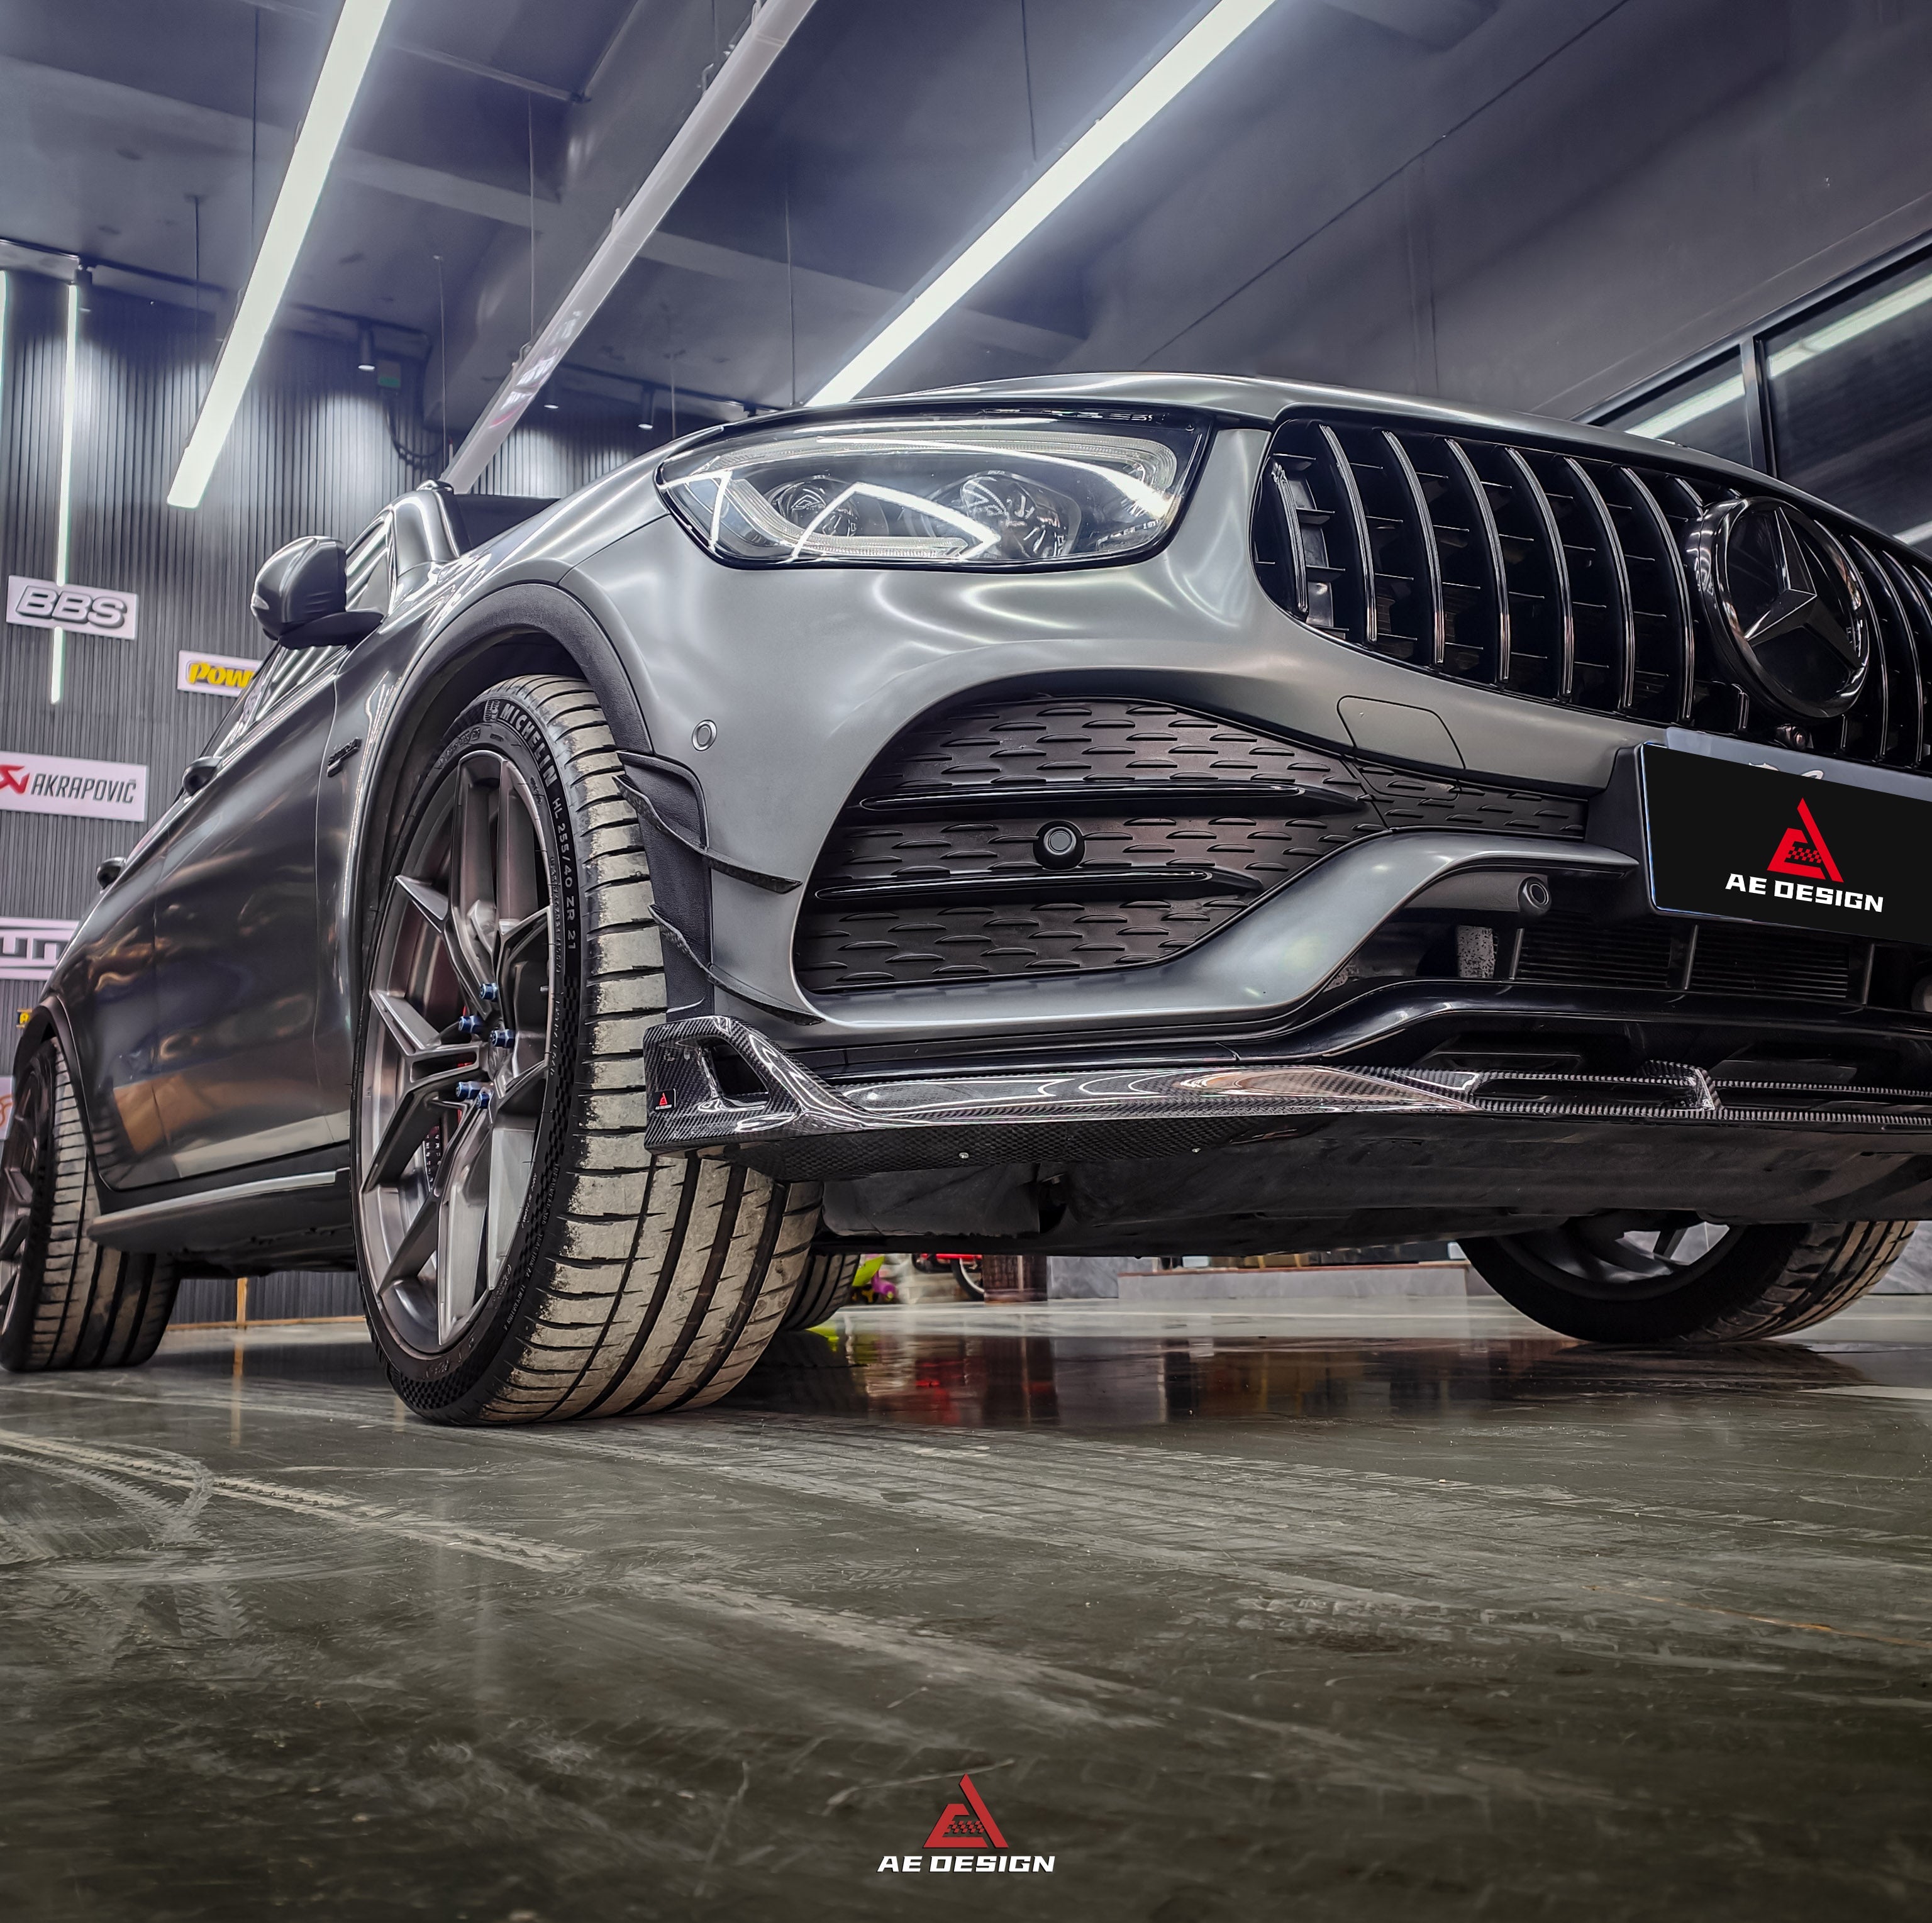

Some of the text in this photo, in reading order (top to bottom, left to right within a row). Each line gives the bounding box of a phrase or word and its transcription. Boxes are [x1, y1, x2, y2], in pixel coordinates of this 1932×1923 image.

[16, 585, 127, 628] BBS
[499, 703, 557, 787] MICHELIN
[552, 797, 576, 949] HL 255/40 ZR 21
